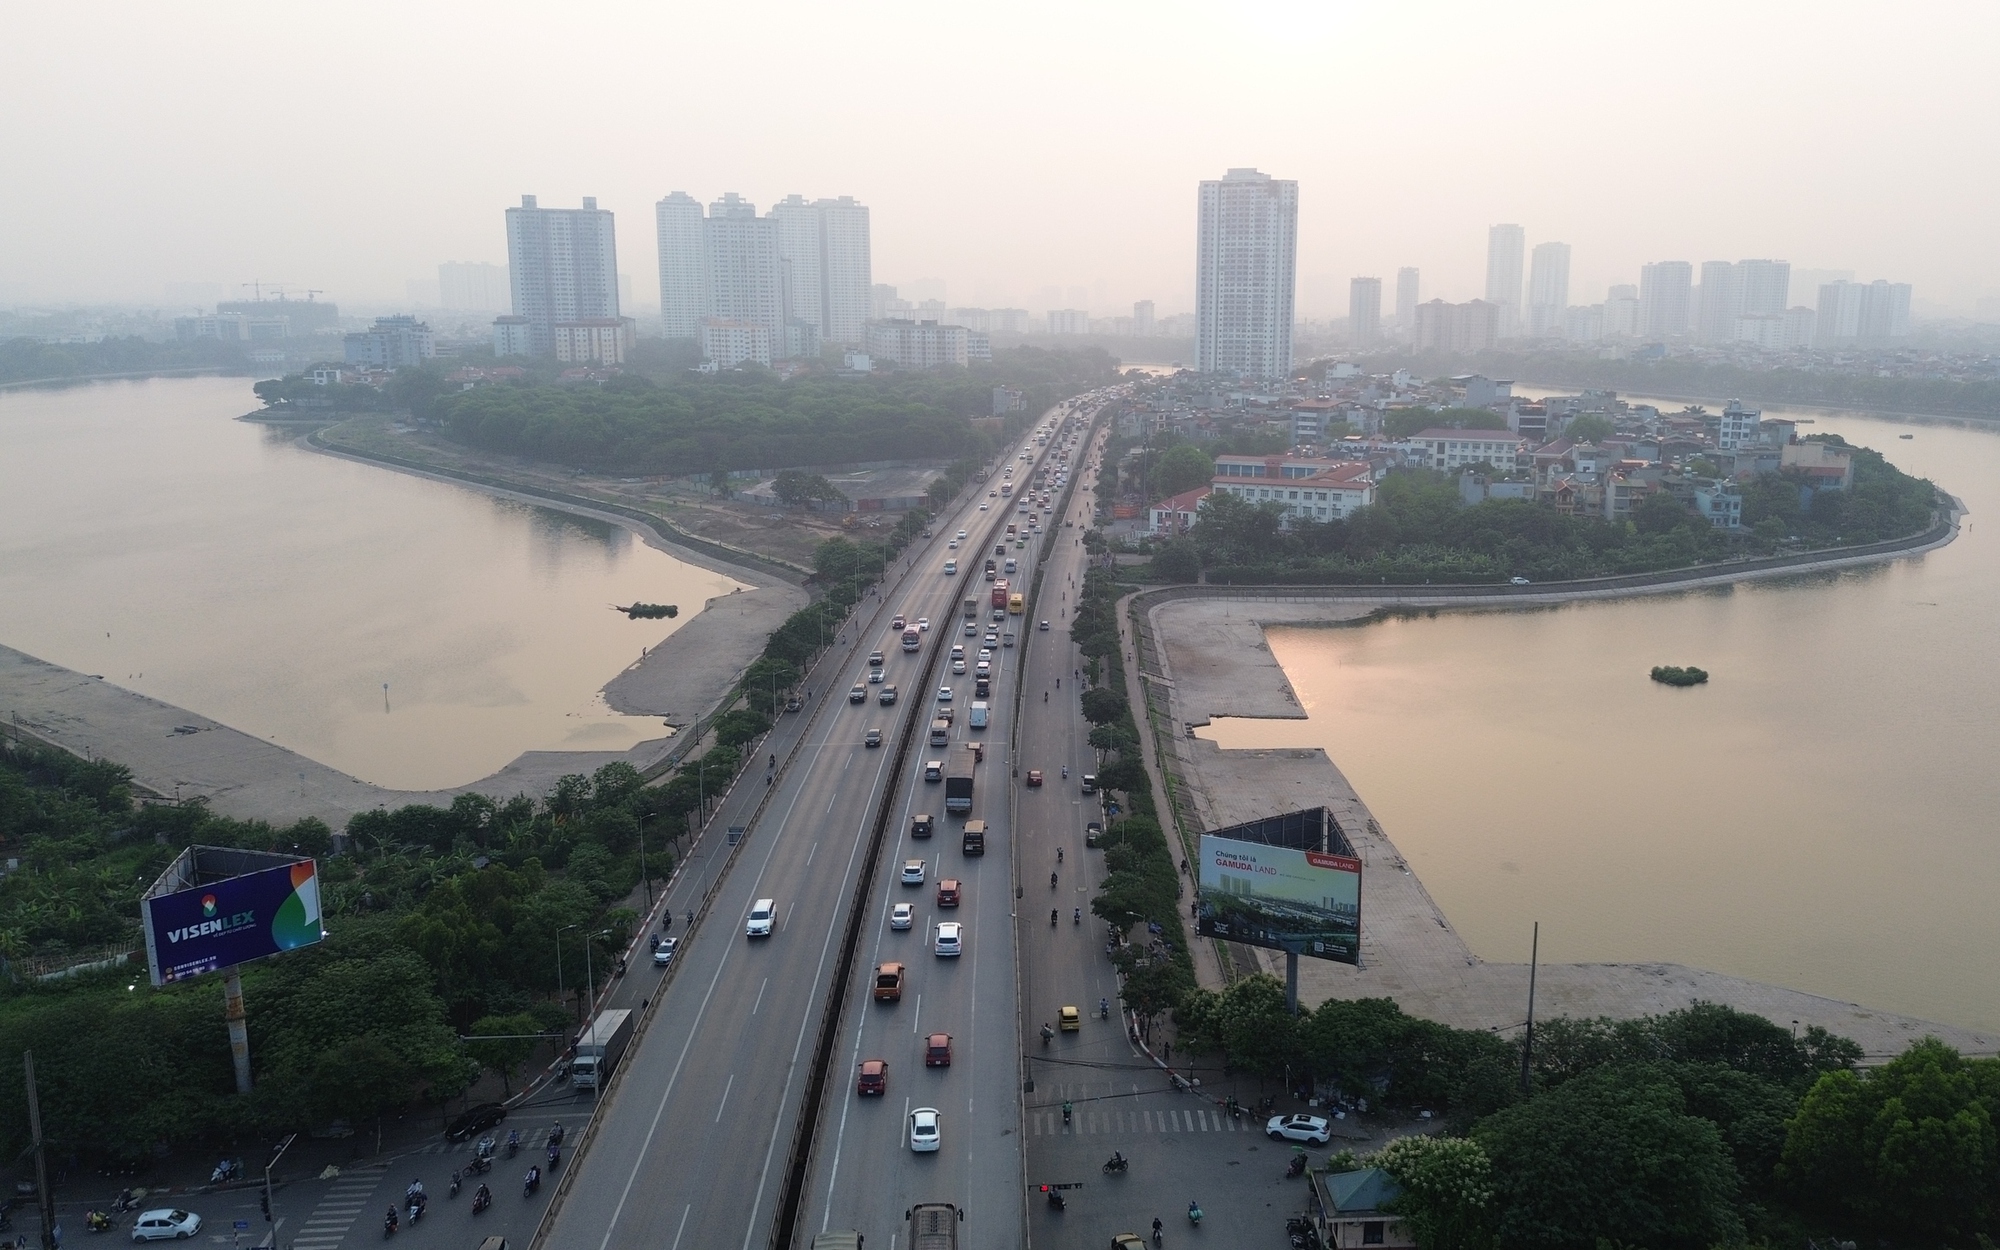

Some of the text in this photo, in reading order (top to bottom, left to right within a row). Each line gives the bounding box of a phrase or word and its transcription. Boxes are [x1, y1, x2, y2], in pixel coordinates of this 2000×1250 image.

[1216, 850, 1237, 861] Chúng
[1216, 858, 1277, 875] GAMUDA LAND
[1313, 858, 1355, 870] GAMUDA LAND
[167, 910, 255, 943] VISENLEX
